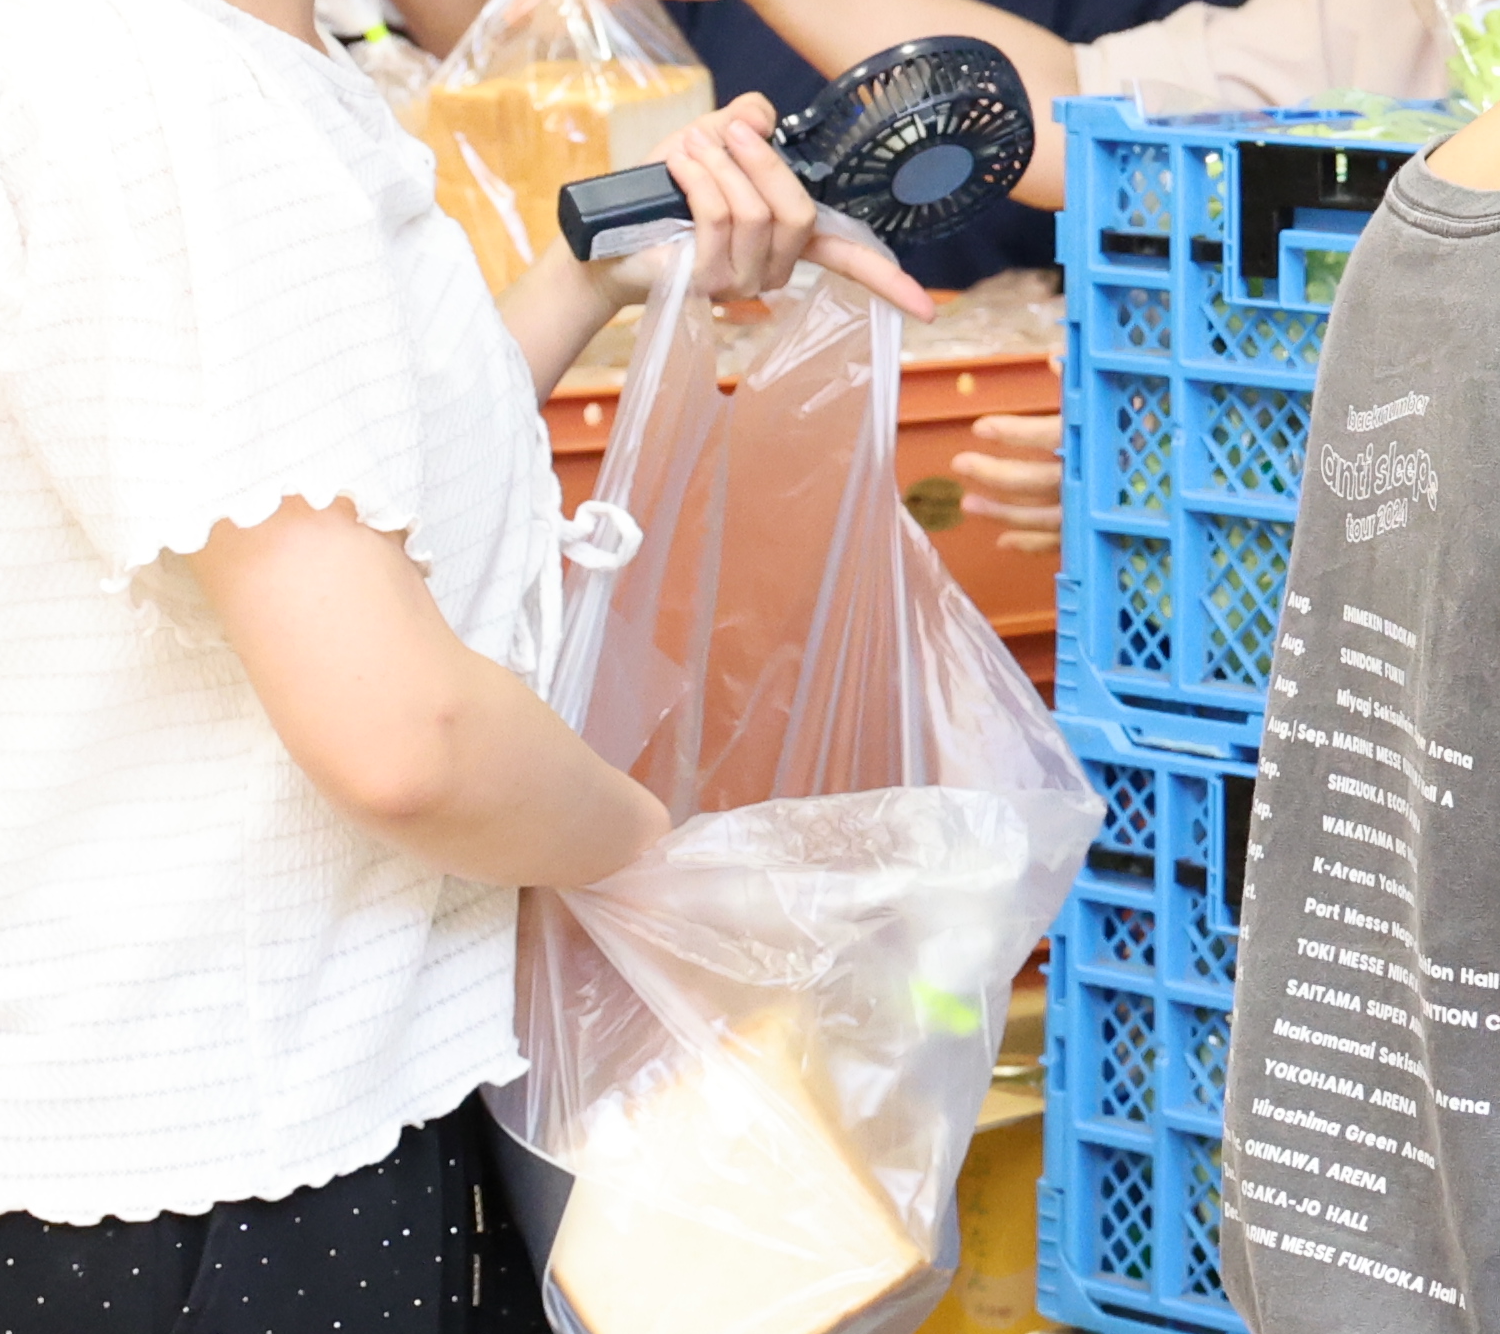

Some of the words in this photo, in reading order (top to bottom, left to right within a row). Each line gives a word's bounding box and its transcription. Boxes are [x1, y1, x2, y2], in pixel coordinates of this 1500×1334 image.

[1320, 442, 1374, 500] anti
[1346, 513, 1376, 543] tour
[1287, 590, 1312, 615] Aug.
[1281, 632, 1306, 657] Aug.
[1339, 646, 1384, 677] SUNDOME
[1274, 673, 1299, 699] Aug.
[1336, 688, 1372, 718] Miyagi
[1428, 740, 1474, 771] Arena
[1327, 772, 1385, 806] SHIZUOKA
[1332, 730, 1374, 760] MARINE
[1376, 744, 1403, 772] MESSE
[1440, 789, 1454, 809] A
[1322, 814, 1394, 852] WAKAYAMA
[1313, 855, 1376, 887] K-Arena
[1297, 937, 1335, 963] TOKI
[1338, 947, 1385, 977] MESSE
[1304, 896, 1339, 921] Port
[1343, 906, 1389, 935] Messe
[1460, 966, 1500, 991] Hall
[1285, 978, 1361, 1013] SAITAMA
[1366, 999, 1408, 1031] SUPER
[1272, 1017, 1377, 1061] Makomanai
[1264, 1057, 1365, 1101] YOKOHAMA
[1368, 1087, 1417, 1118] ARENA
[1252, 1097, 1341, 1138] Hiroshima
[1345, 1123, 1398, 1155] Green
[1401, 1140, 1436, 1170] Arena
[1244, 1138, 1321, 1176] OKINAWA
[1325, 1162, 1388, 1195] ARENA
[1240, 1180, 1322, 1218] OSAKA-JO
[1325, 1204, 1369, 1233] HALL
[1280, 1233, 1337, 1264] MESSE
[1337, 1250, 1425, 1295] FUKUOKA
[1428, 1279, 1458, 1307] Hall
